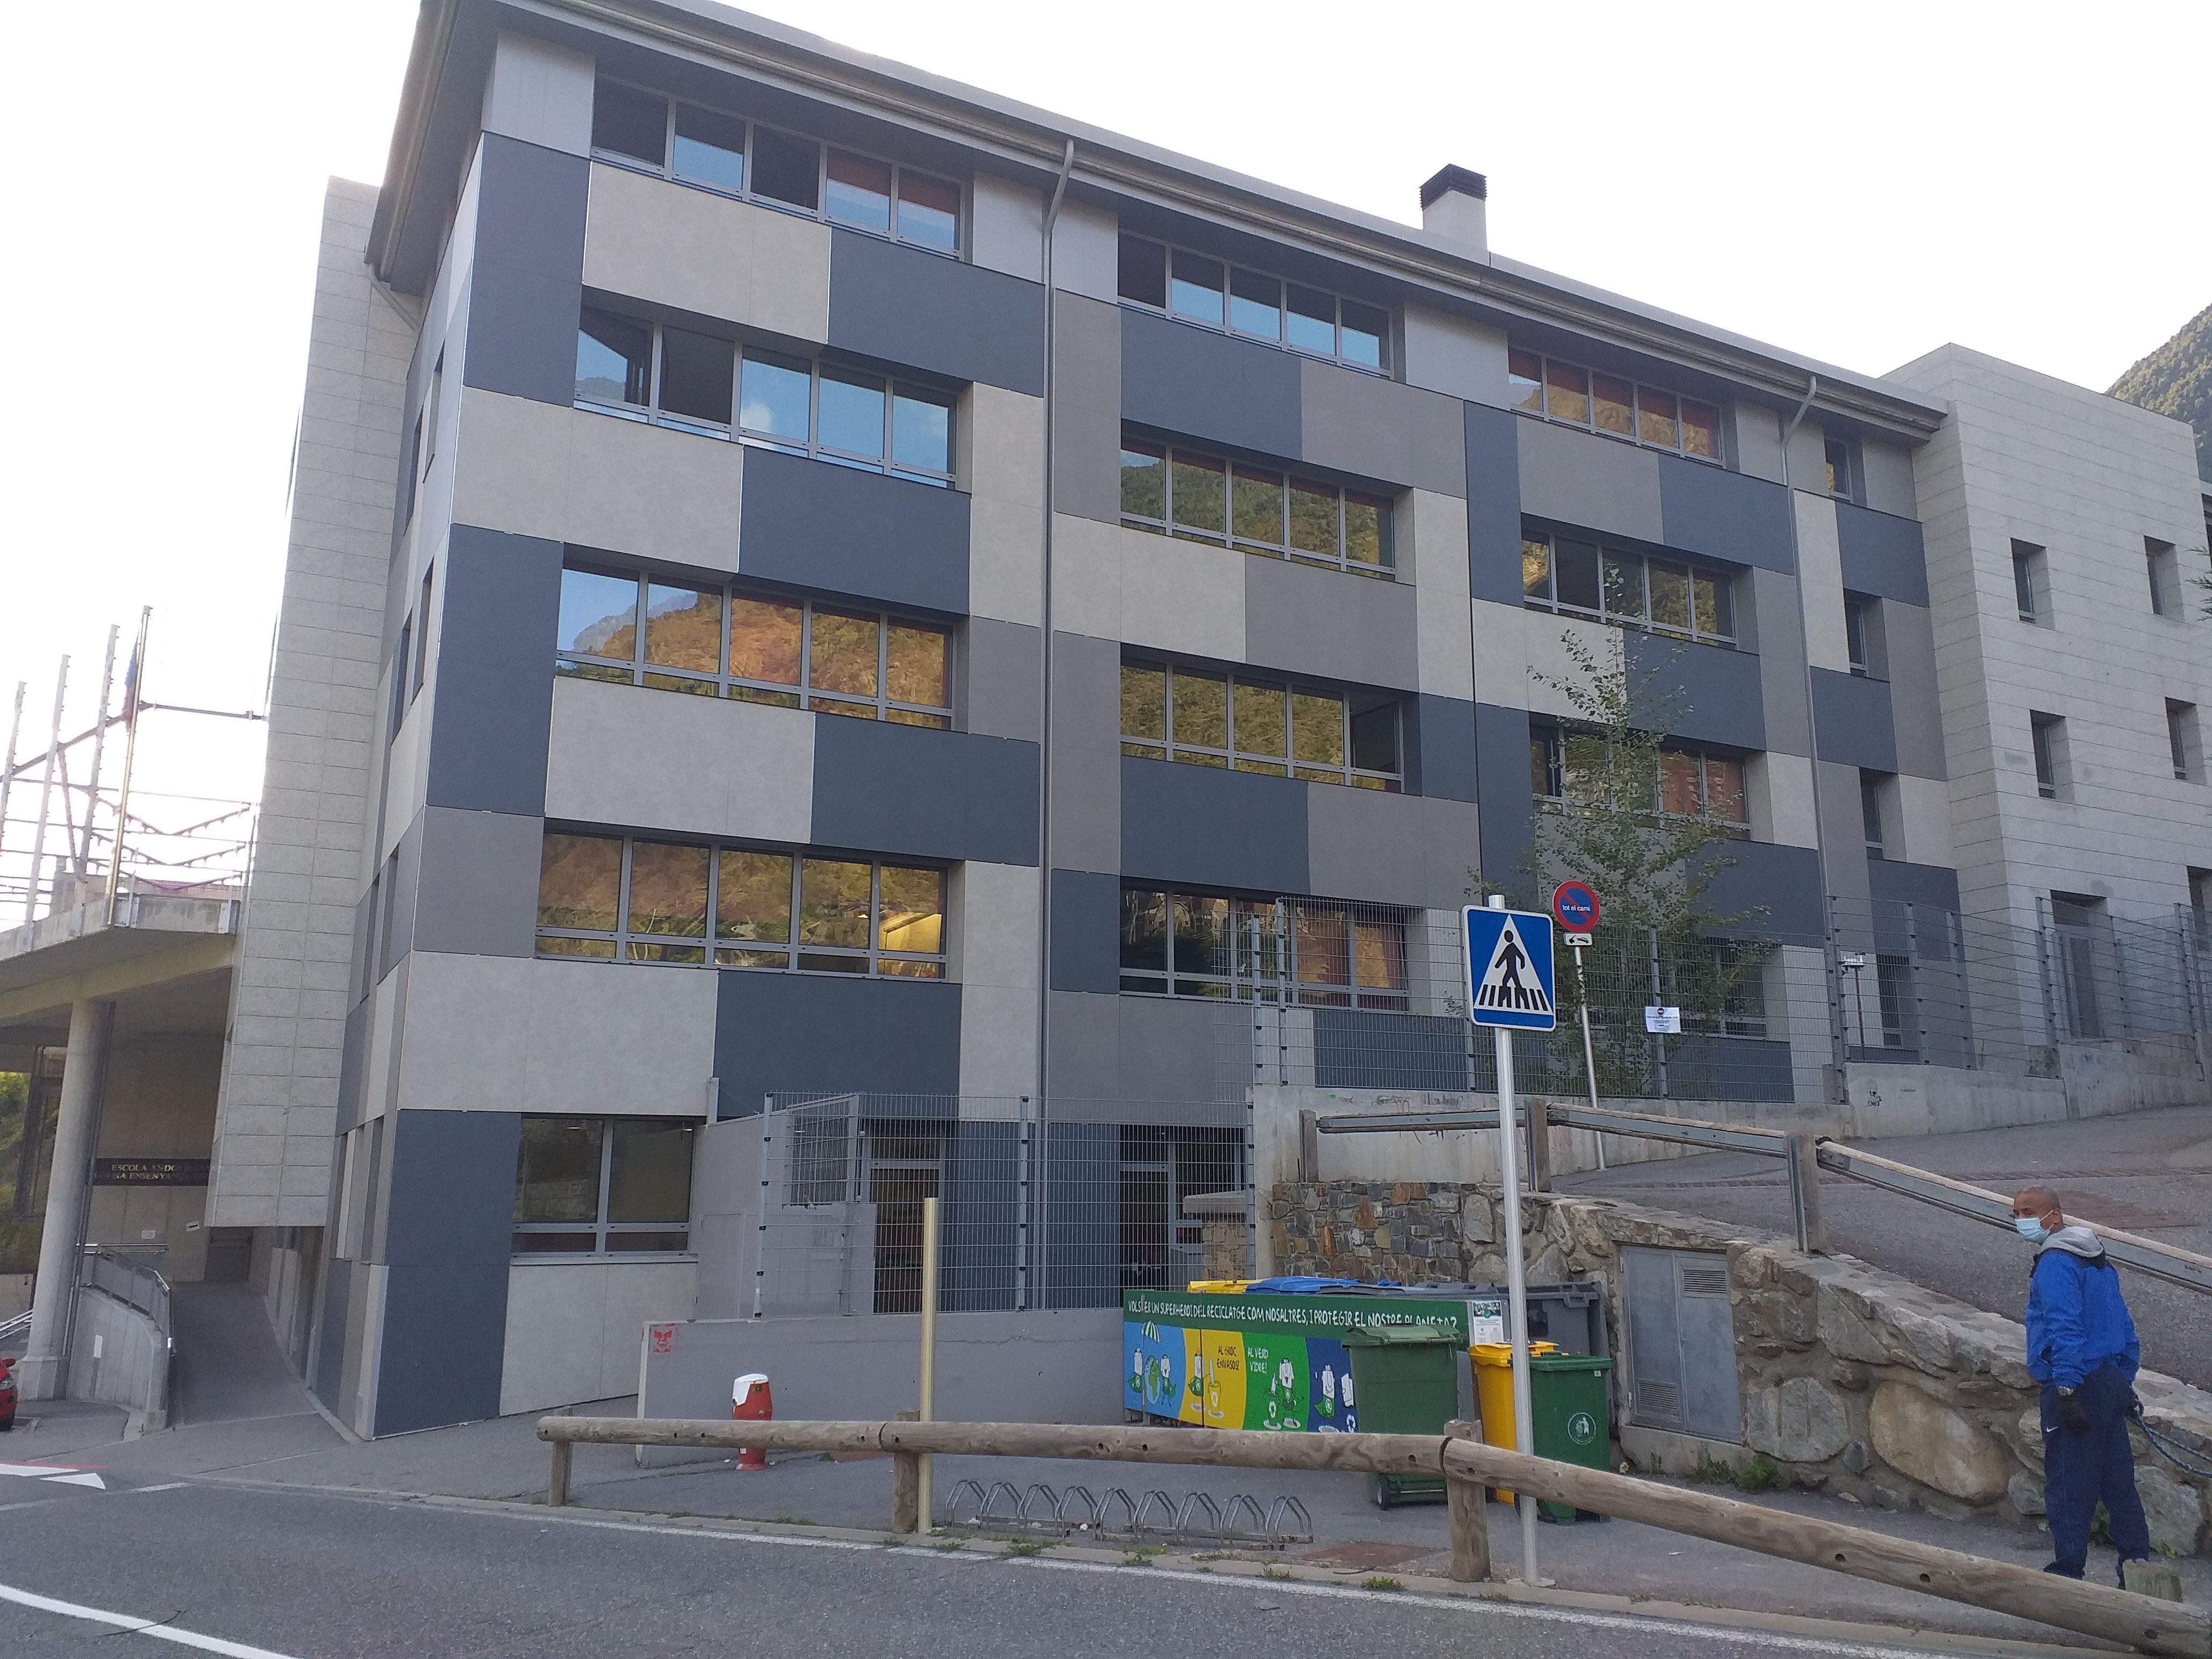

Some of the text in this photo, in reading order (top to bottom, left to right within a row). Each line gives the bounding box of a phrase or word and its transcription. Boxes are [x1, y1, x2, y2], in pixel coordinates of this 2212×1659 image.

[111, 1164, 147, 1172] ESCOLA
[1129, 1300, 1141, 1313] VOLS
[1141, 1301, 1151, 1313] ER
[1151, 1302, 1160, 1314] UN
[1160, 1302, 1193, 1317] SUPERHEROI
[1193, 1304, 1206, 1318] DEL
[1207, 1304, 1246, 1320] RECICLATGE
[1246, 1307, 1265, 1322] COM
[1266, 1308, 1308, 1326] NOSALTRES,
[1314, 1310, 1353, 1326] PROTEGIR
[1354, 1311, 1366, 1327] EL
[1218, 1345, 1237, 1357] AL GROC
[1247, 1347, 1269, 1359] AL VERD
[1216, 1358, 1239, 1372] ENVASOS!
[1250, 1361, 1267, 1374] VIDRE!
